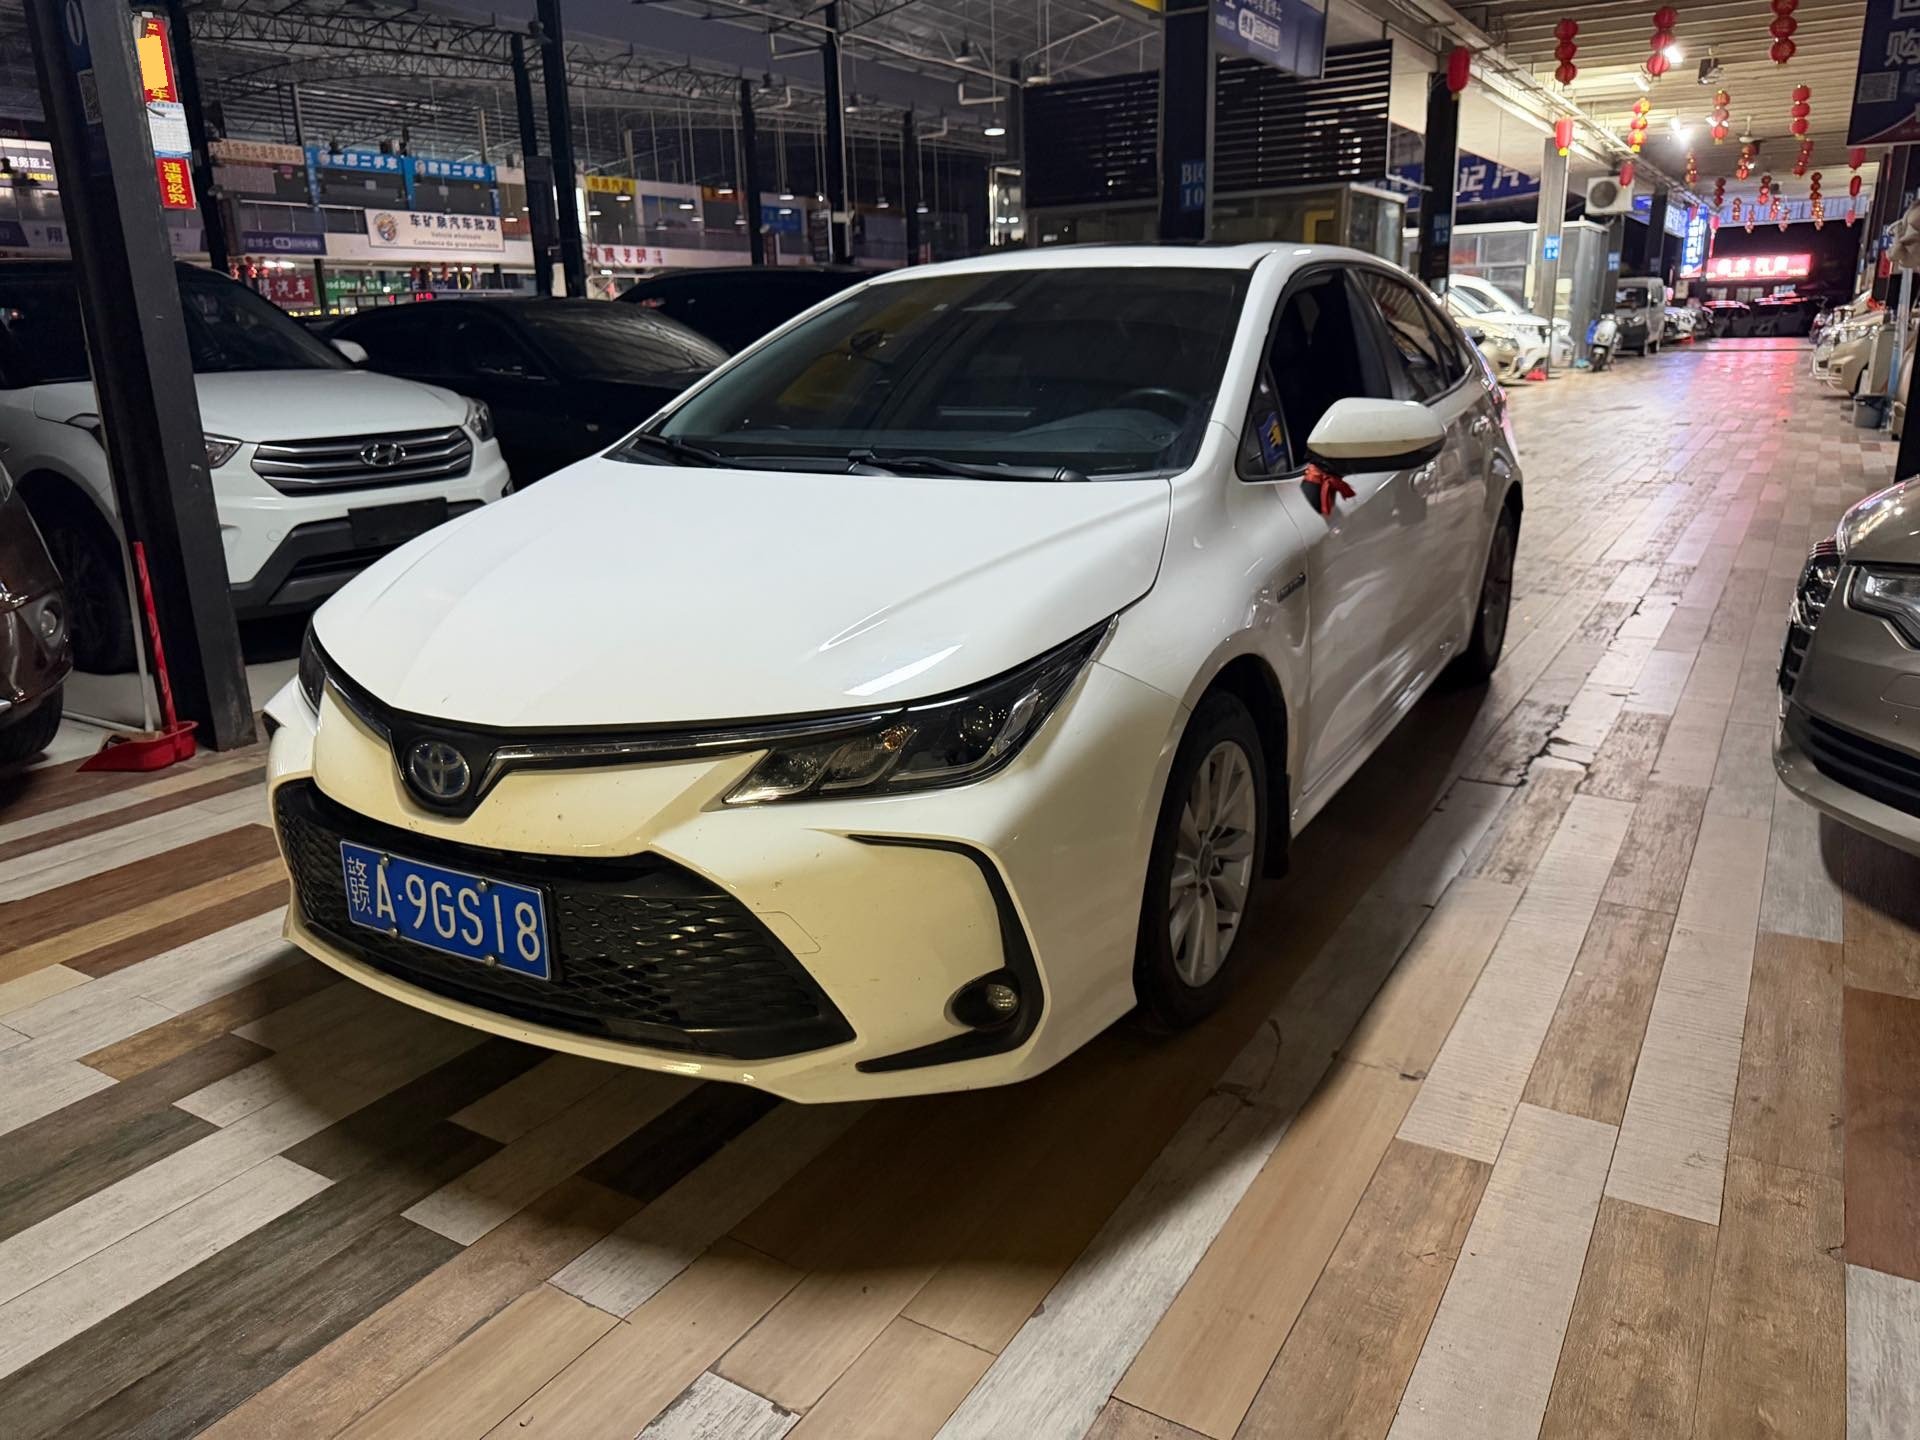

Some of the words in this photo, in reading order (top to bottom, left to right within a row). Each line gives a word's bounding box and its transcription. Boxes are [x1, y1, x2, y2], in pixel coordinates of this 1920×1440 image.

[163, 161, 188, 204] 违者必究
[1185, 188, 1204, 206] 10
